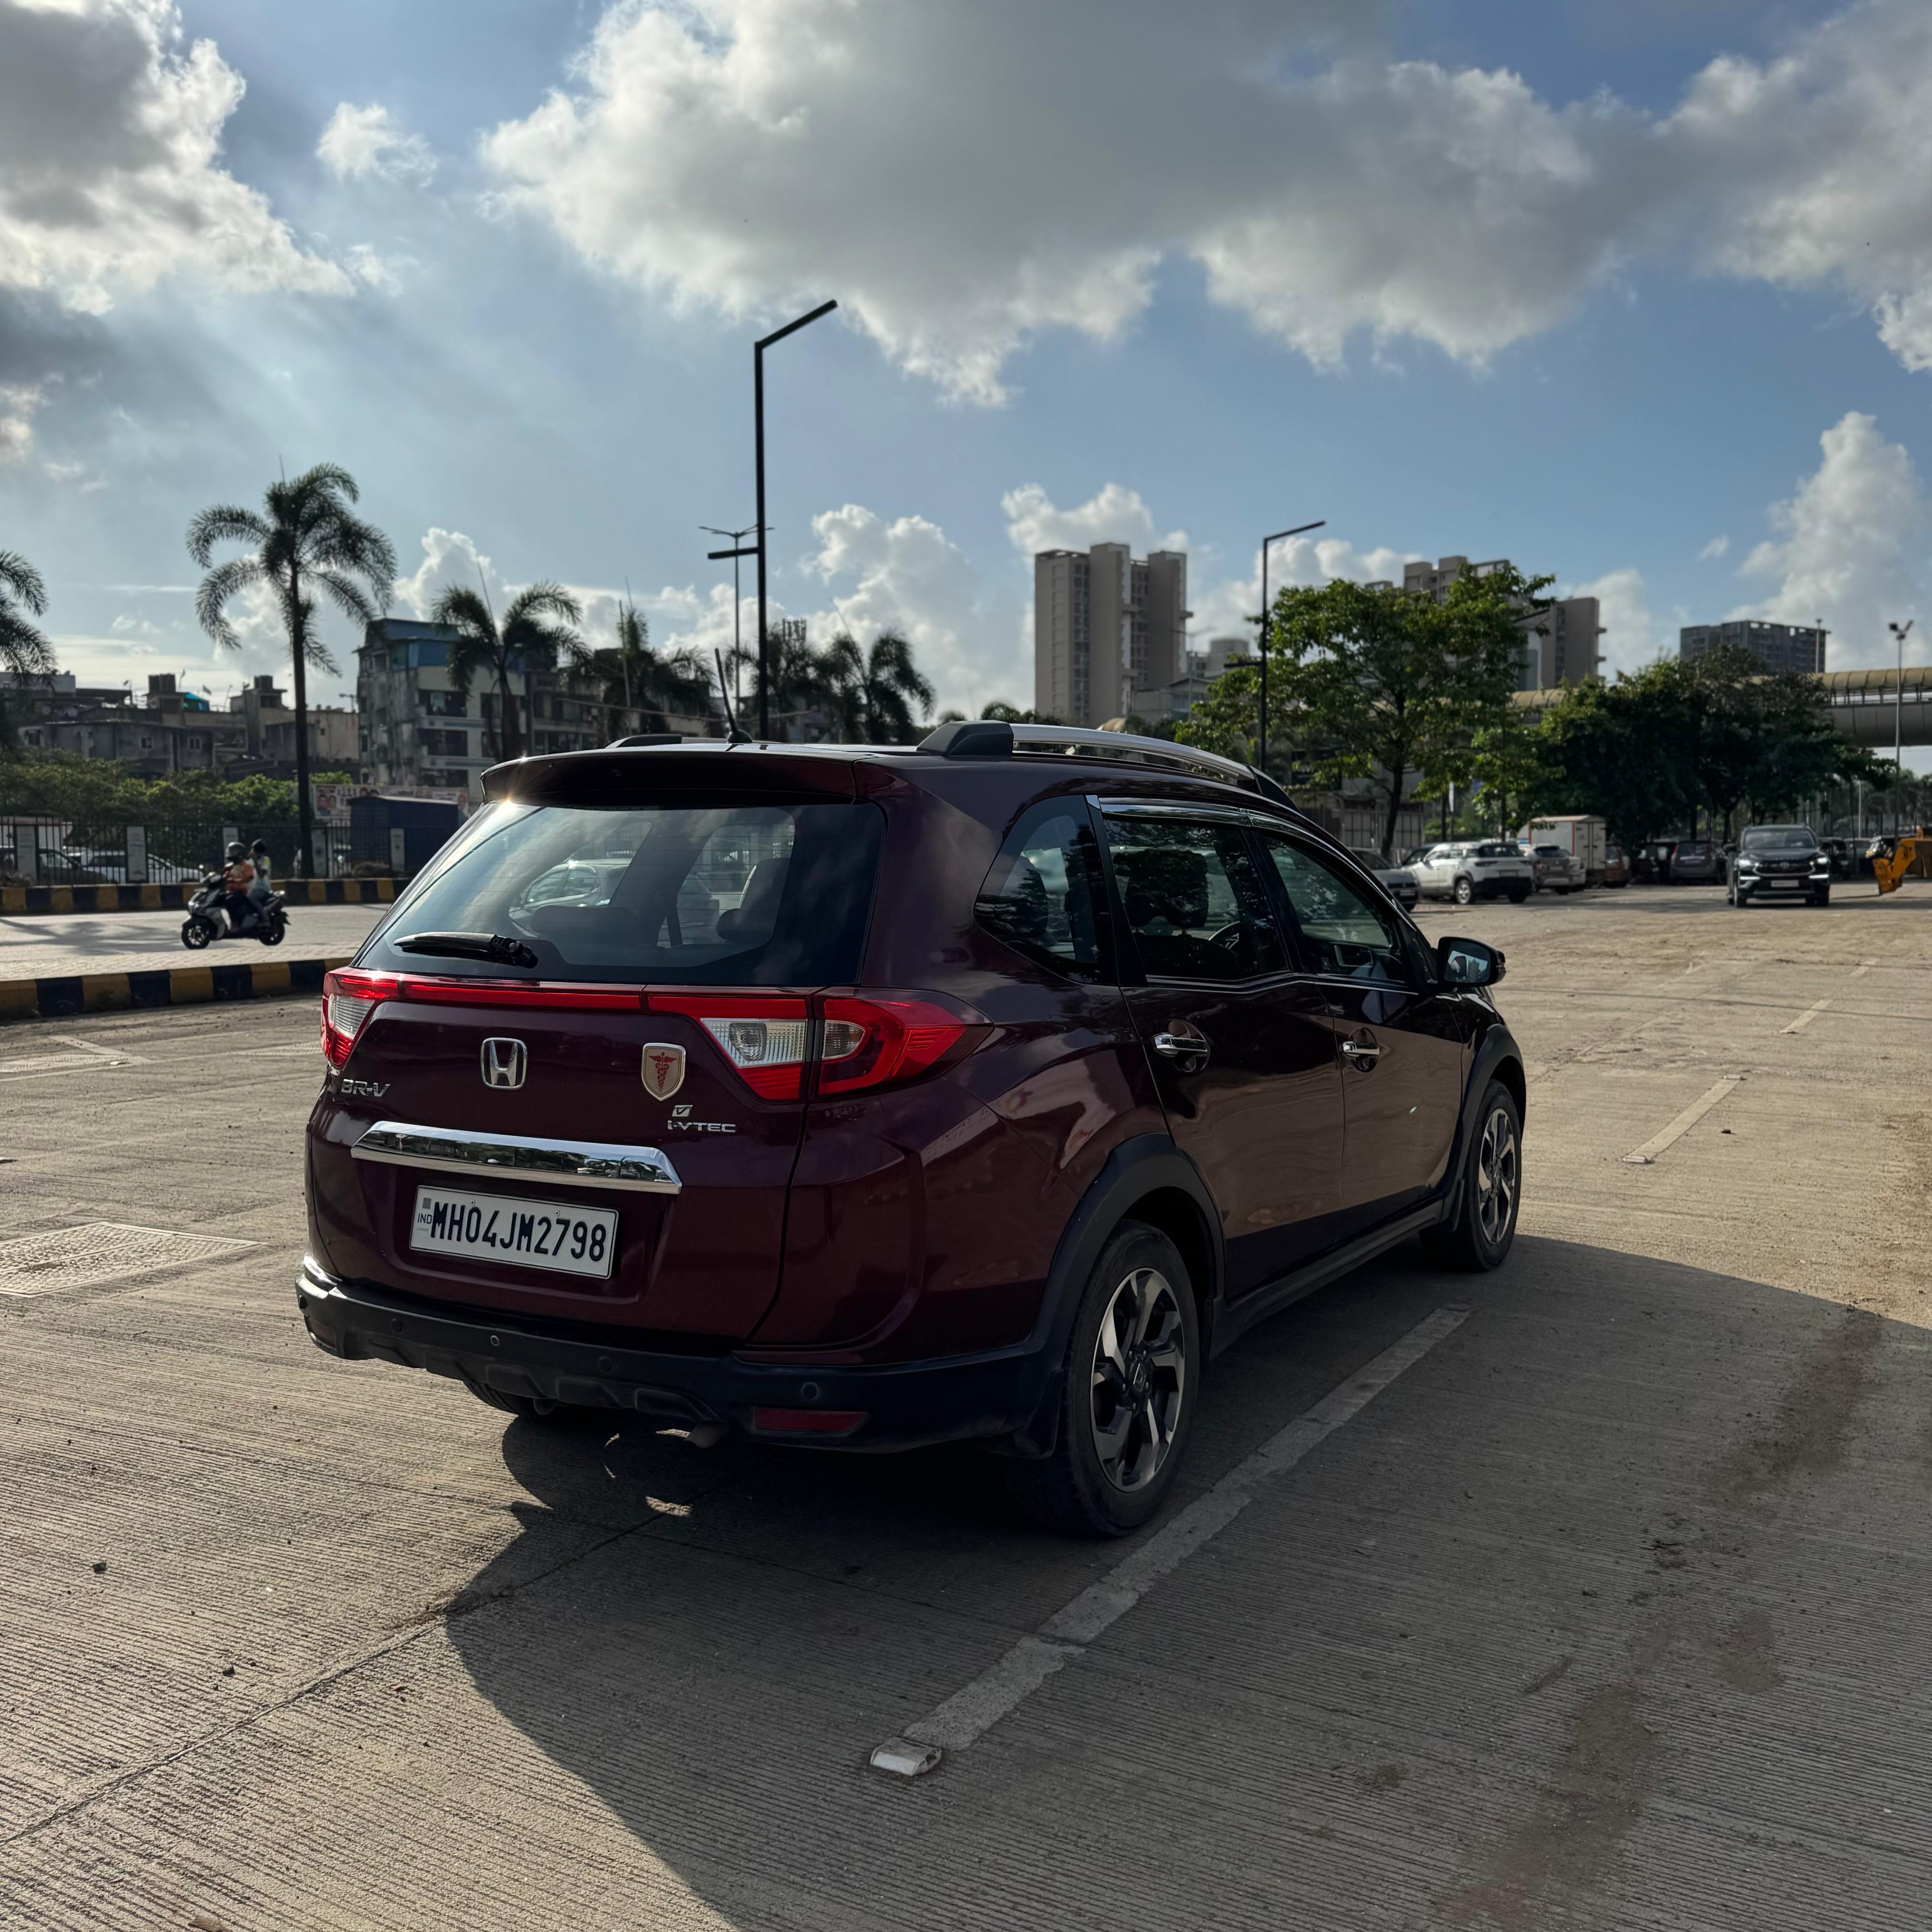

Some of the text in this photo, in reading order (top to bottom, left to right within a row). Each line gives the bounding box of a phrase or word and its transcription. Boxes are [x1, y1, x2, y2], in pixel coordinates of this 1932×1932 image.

[341, 1079, 391, 1097] BR-V
[418, 1213, 432, 1224] IND
[431, 1202, 606, 1261] MH04JM2798
